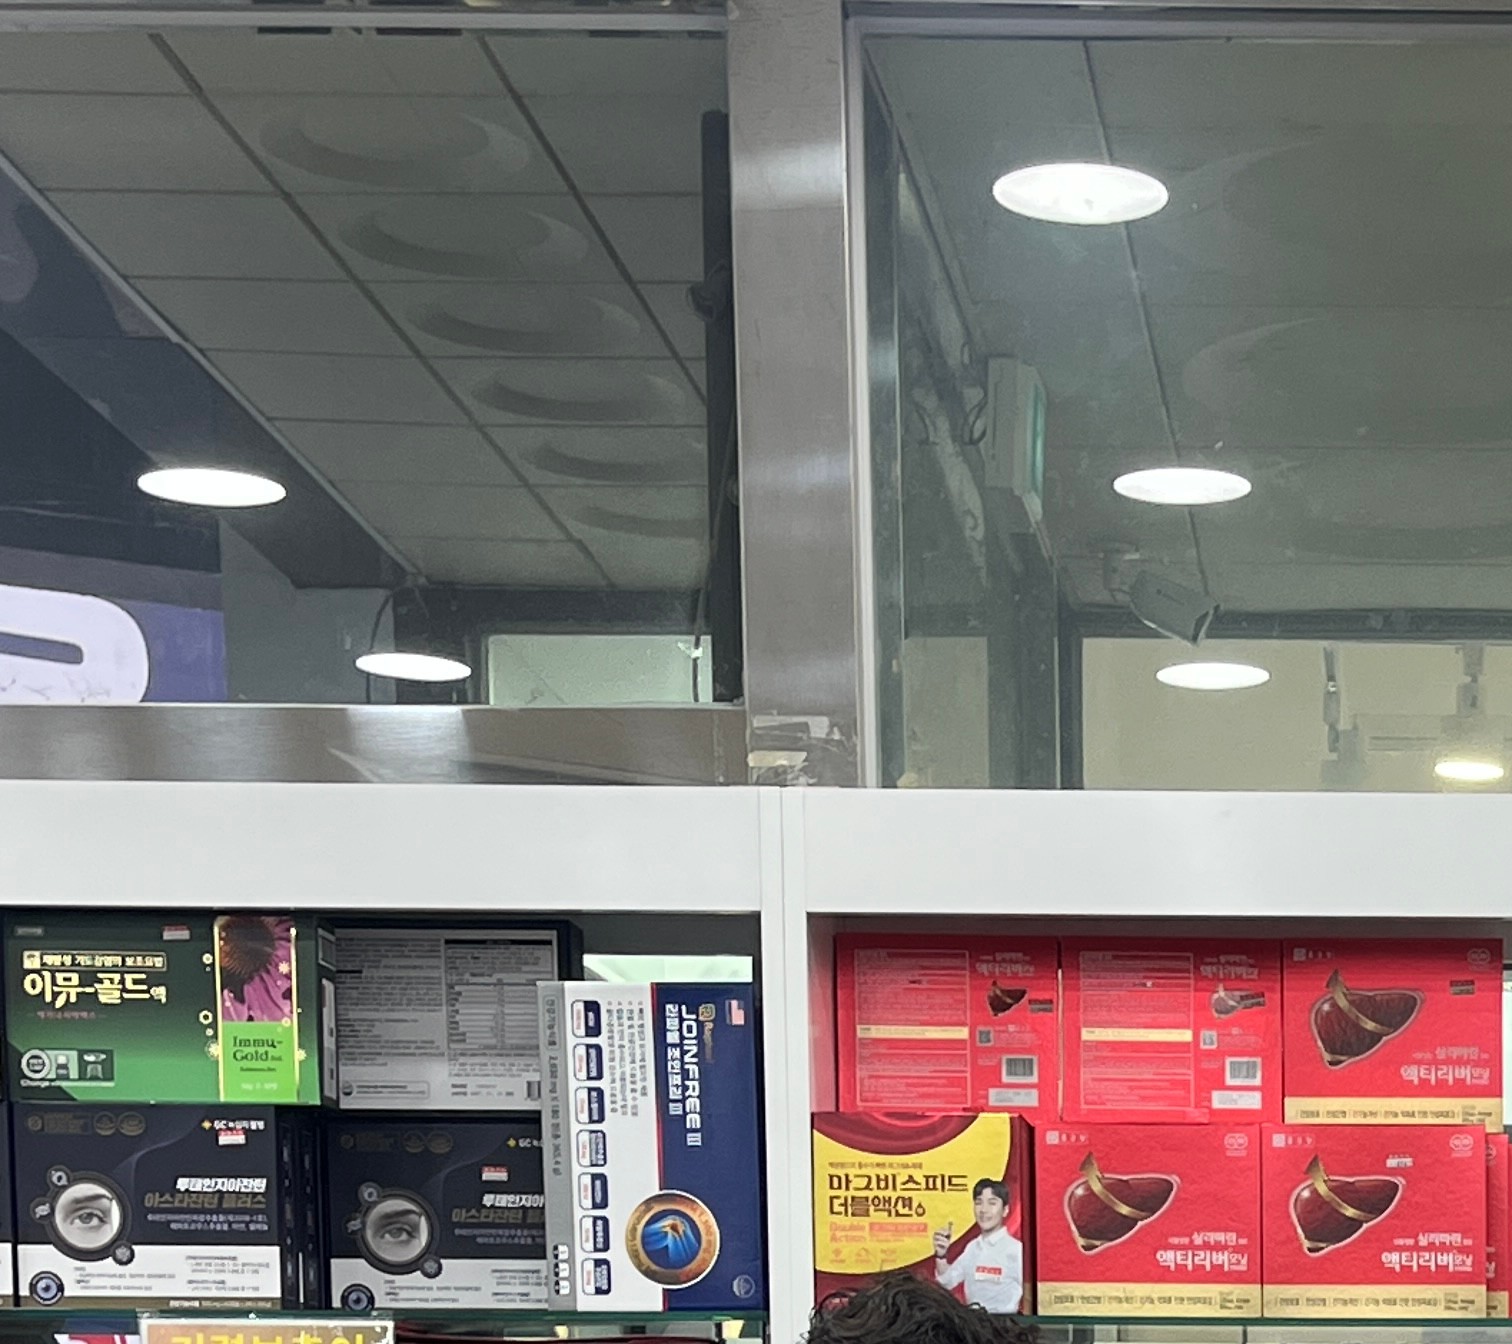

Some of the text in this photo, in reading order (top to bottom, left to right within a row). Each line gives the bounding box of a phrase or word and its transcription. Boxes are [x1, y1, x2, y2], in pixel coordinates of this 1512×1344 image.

[233, 1036, 283, 1049] Immu-
[233, 1049, 269, 1062] Gold
[681, 1004, 702, 1129] JOINFREE
[1401, 1063, 1474, 1086] 액티리버
[1156, 1248, 1230, 1272] 액티리버
[1382, 1248, 1455, 1272] 액티리버
